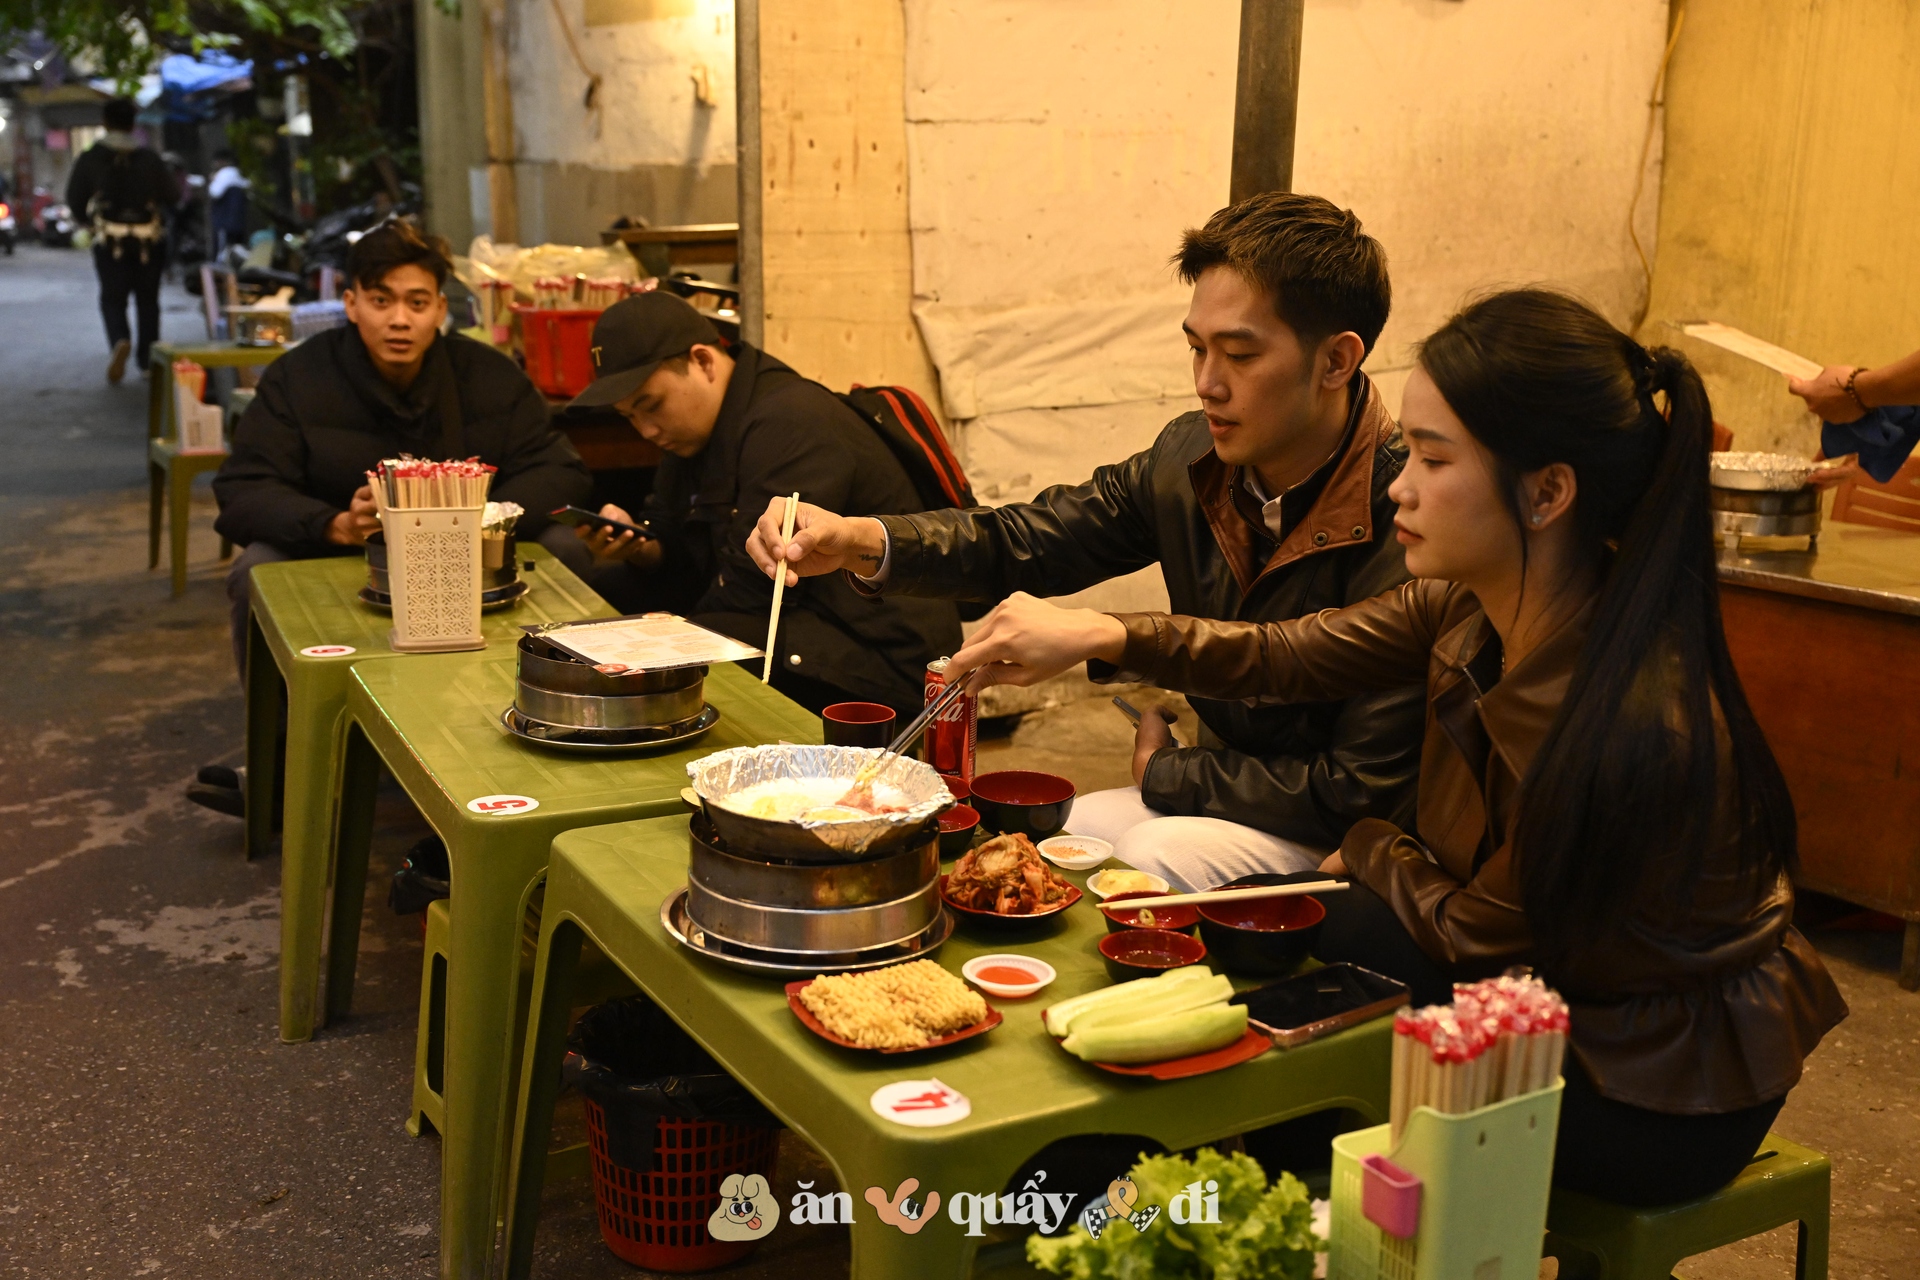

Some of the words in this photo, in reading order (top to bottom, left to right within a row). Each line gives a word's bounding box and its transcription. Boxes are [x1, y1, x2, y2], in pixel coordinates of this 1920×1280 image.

[591, 346, 602, 367] T
[477, 799, 528, 811] 5
[891, 1090, 950, 1112] 4
